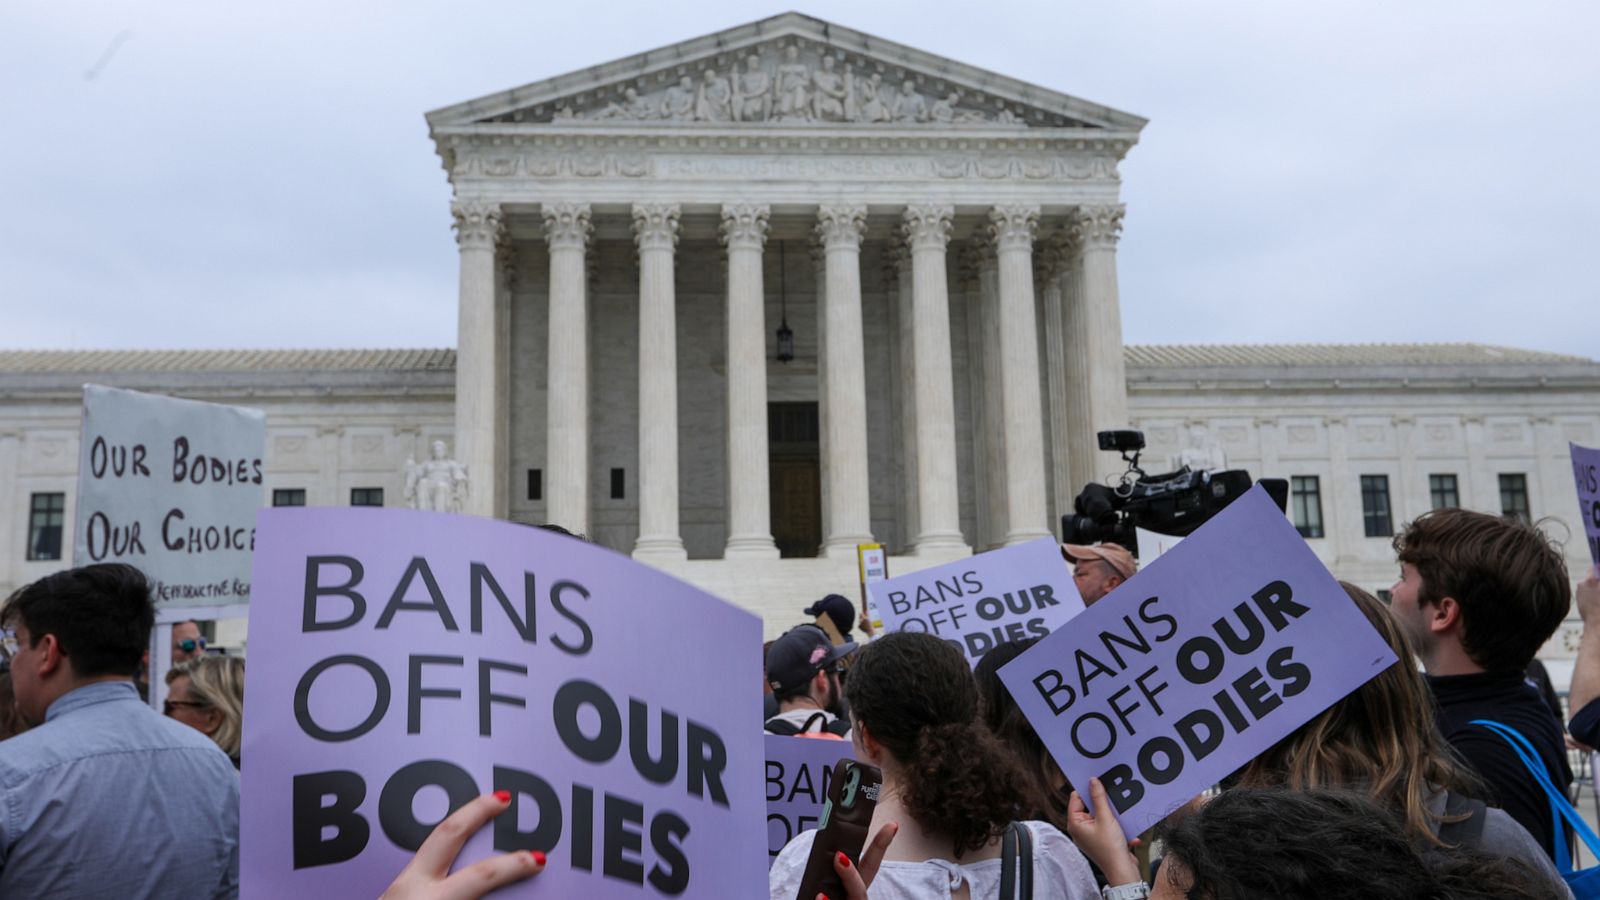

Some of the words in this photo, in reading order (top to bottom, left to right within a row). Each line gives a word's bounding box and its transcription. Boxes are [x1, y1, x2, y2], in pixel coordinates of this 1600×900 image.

[90, 435, 151, 480] OUR
[173, 435, 263, 486] BODIES
[87, 511, 147, 562] OUR
[302, 554, 594, 656] BANS
[888, 571, 984, 616] BANS
[976, 584, 1060, 621] OUR
[1032, 596, 1178, 716] BANS
[1070, 665, 1169, 759] OFF
[1176, 580, 1311, 685] OUR
[293, 653, 528, 743] OFF
[553, 679, 731, 811] OUR
[1098, 646, 1311, 815] BODIES
[293, 759, 691, 897] BODIES
